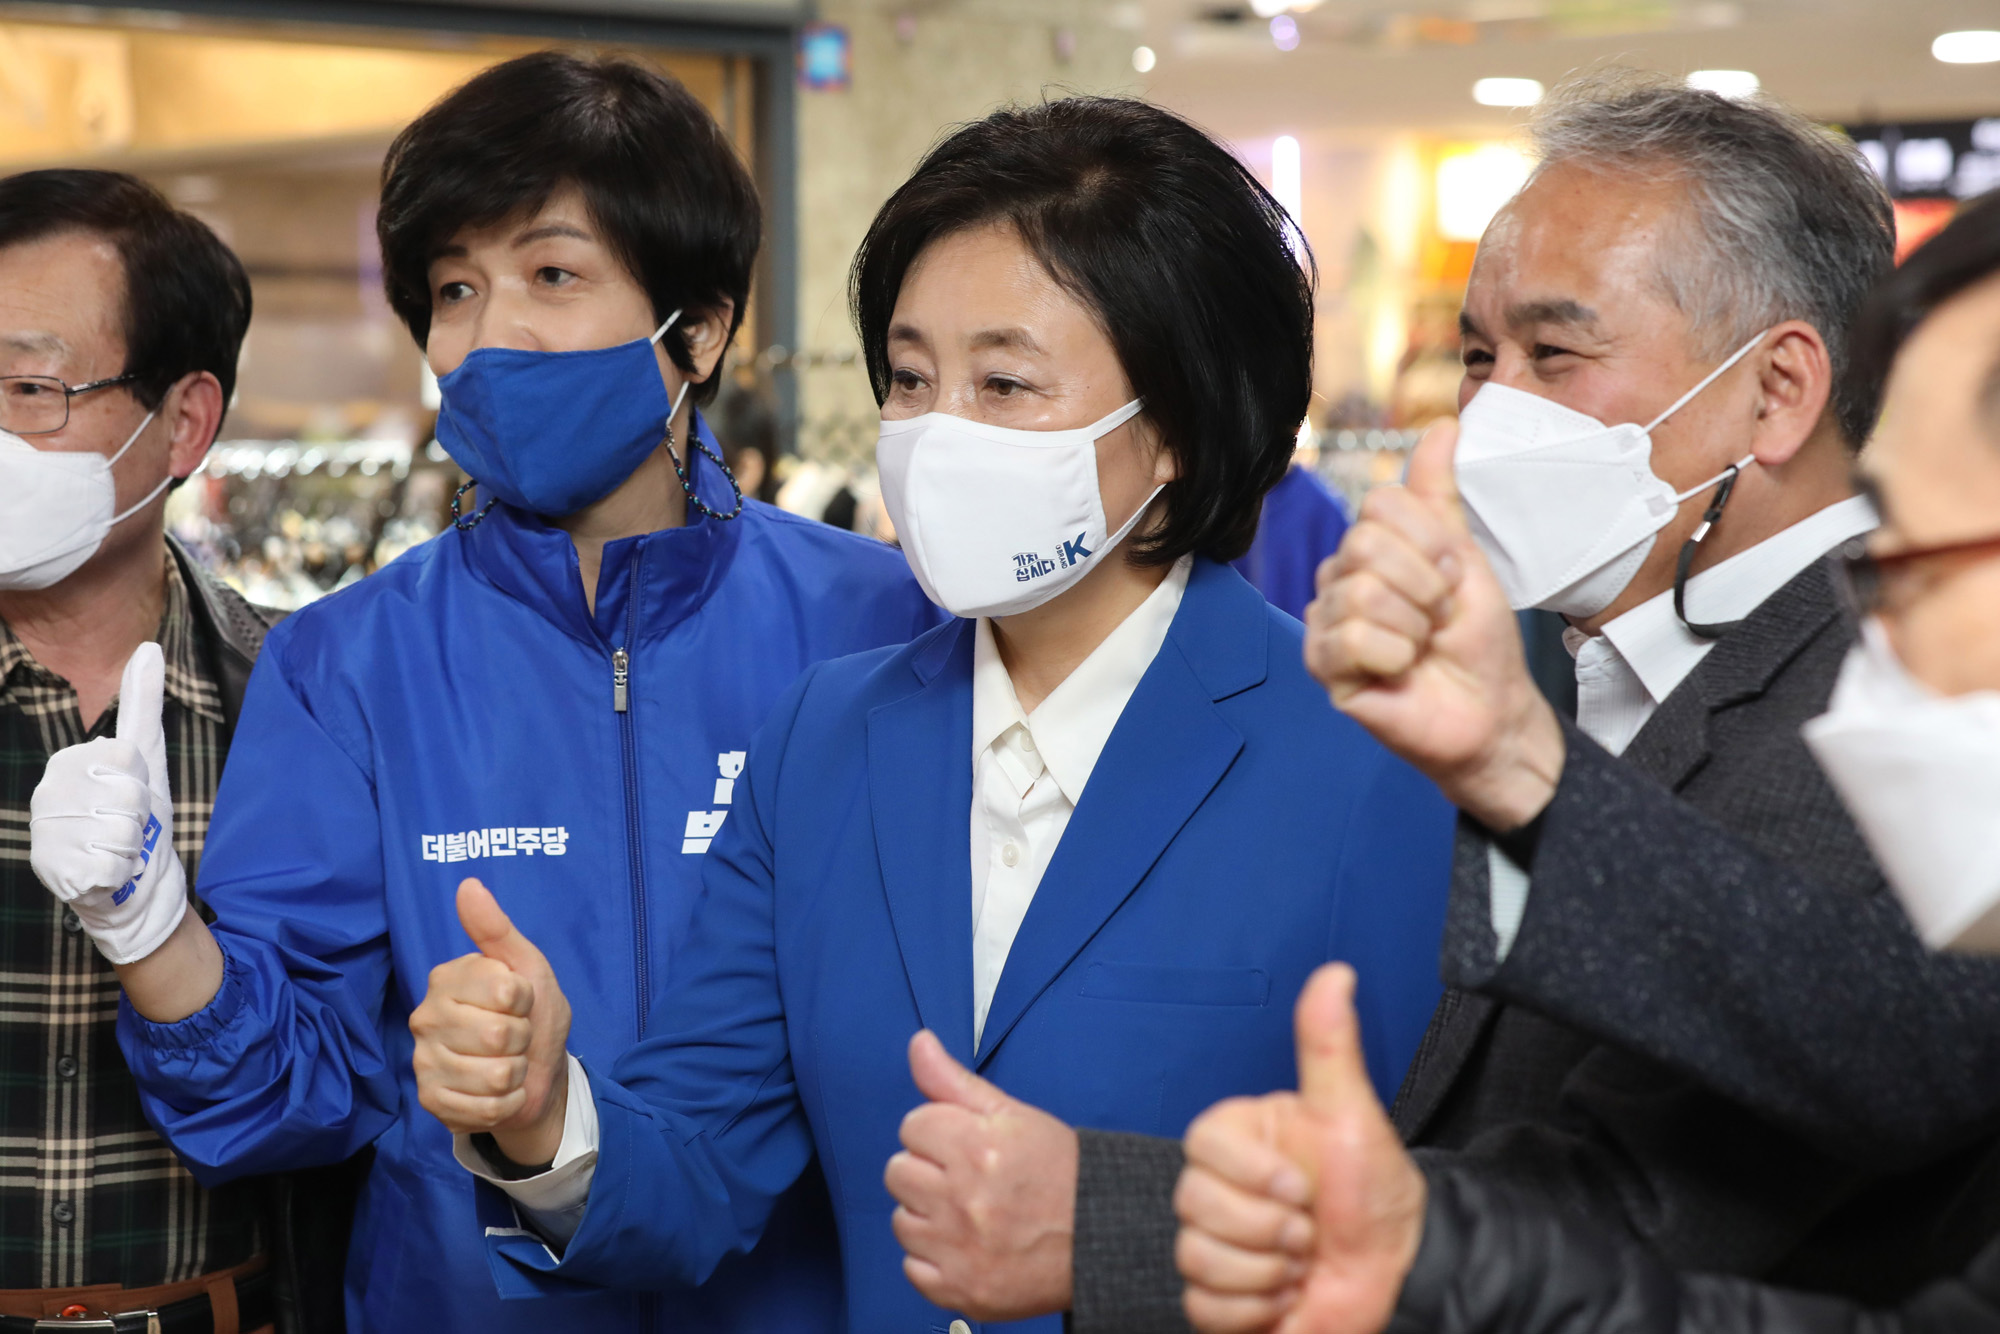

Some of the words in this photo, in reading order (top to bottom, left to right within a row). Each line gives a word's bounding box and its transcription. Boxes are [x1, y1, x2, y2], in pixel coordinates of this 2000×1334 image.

[1063, 530, 1093, 566] K
[1012, 553, 1039, 567] 가치
[1056, 549, 1068, 570] BRAND
[1016, 560, 1056, 582] 삽시다
[421, 826, 570, 864] 더불어민주당
